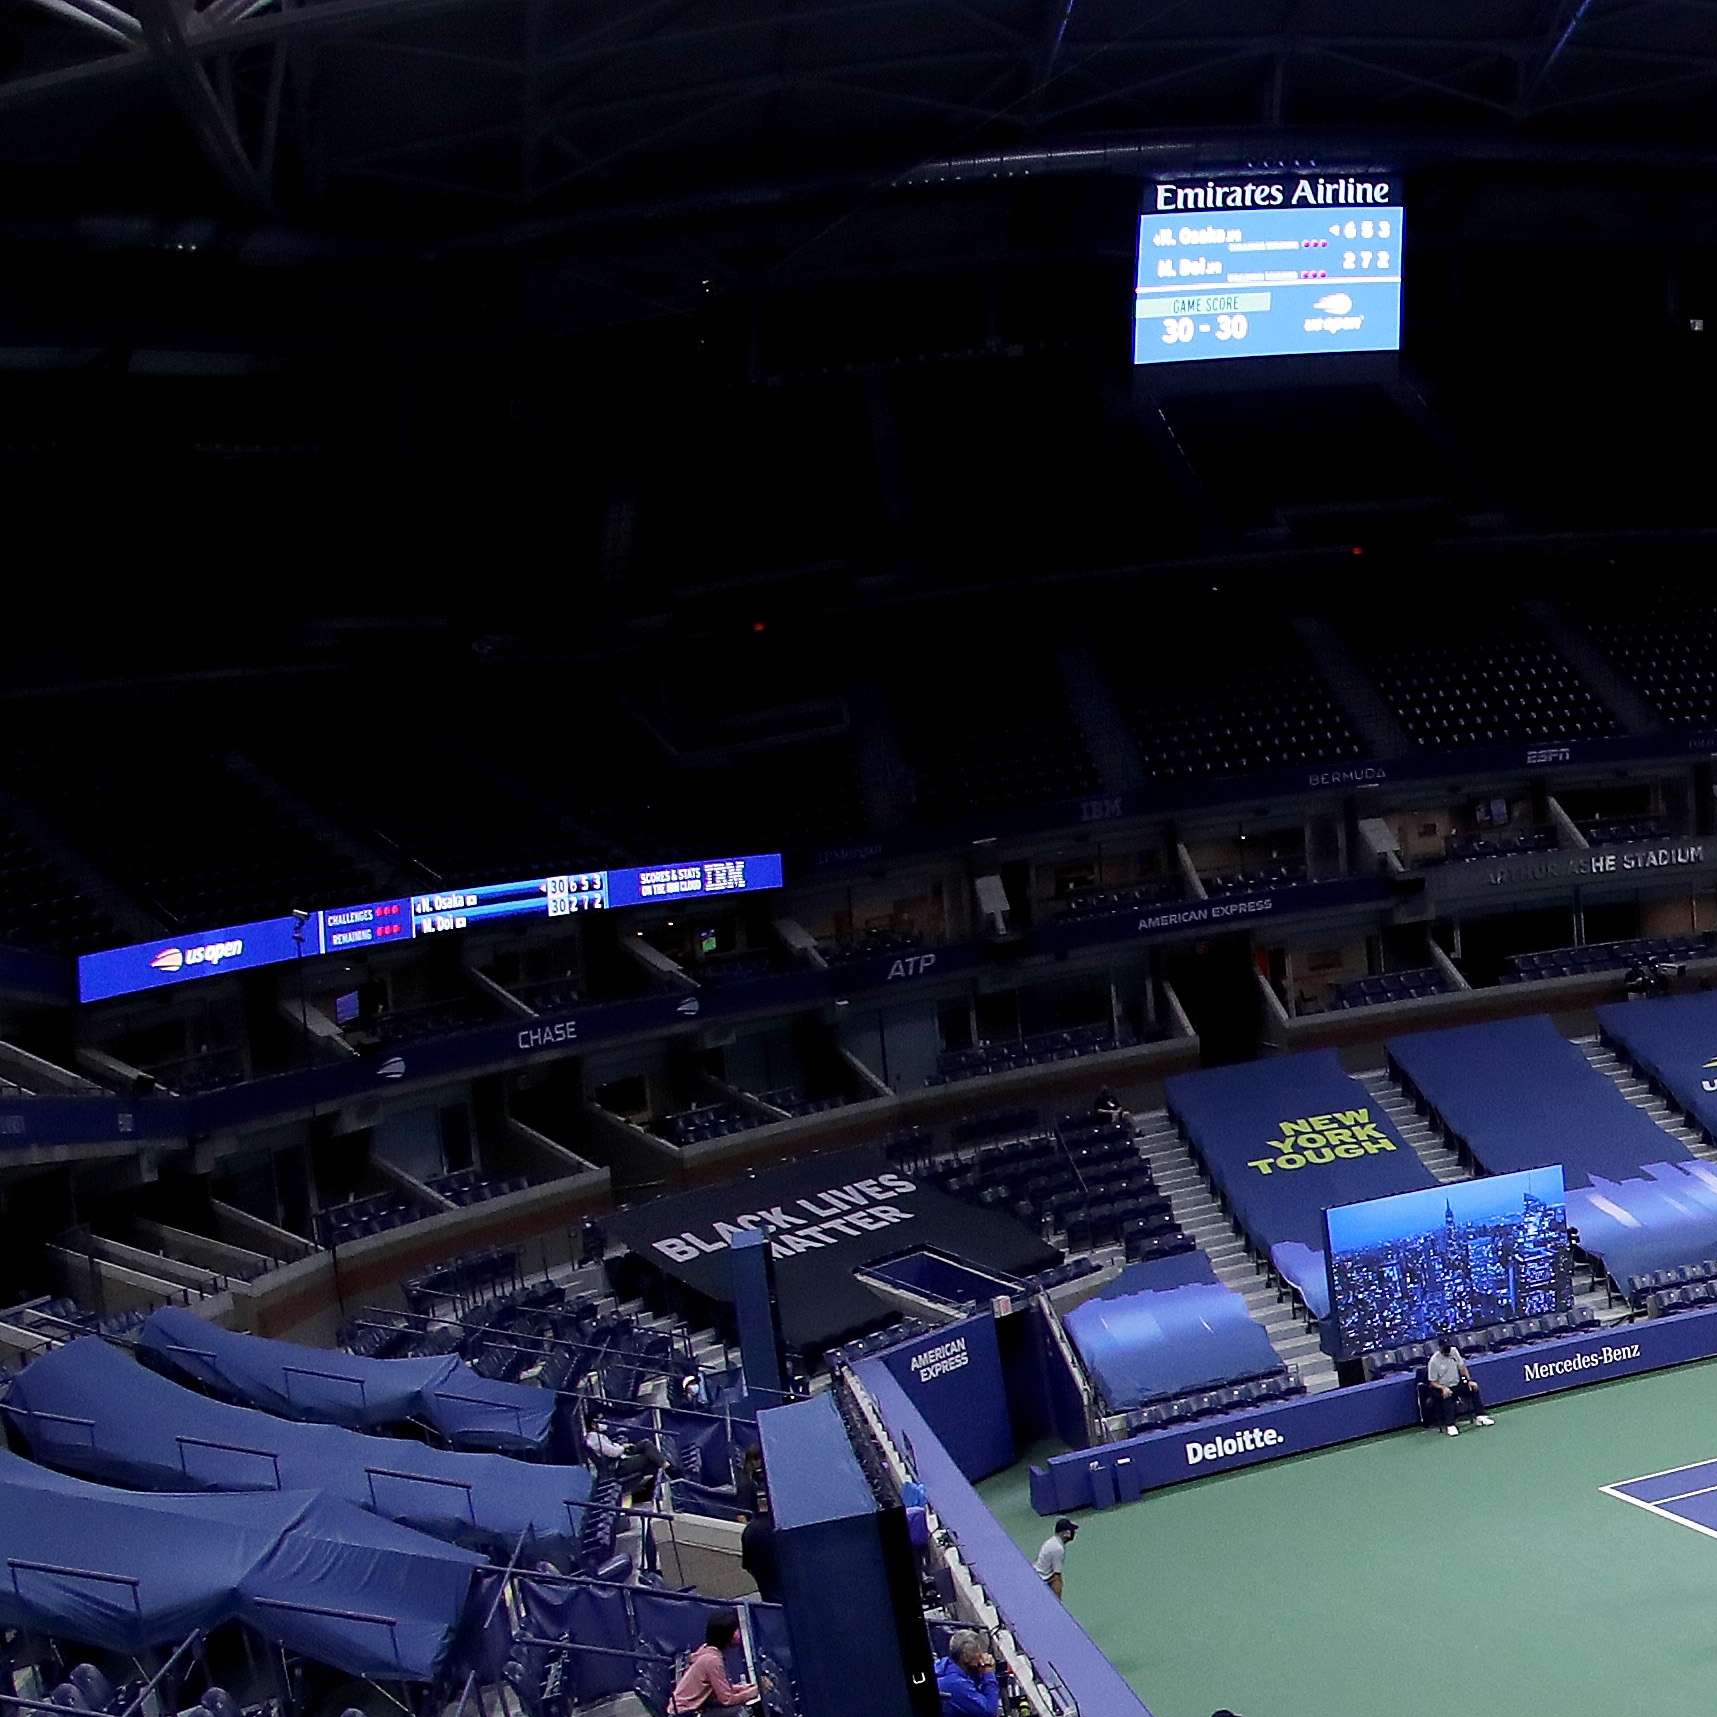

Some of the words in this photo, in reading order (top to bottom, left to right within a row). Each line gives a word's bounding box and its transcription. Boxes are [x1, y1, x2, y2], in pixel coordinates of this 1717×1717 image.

[1156, 181, 1284, 210] Emirates
[1291, 178, 1389, 205] Airline
[1173, 299, 1201, 313] GAME
[1205, 296, 1239, 312] SCORE
[1161, 316, 1194, 344] 30
[1215, 313, 1248, 341] 30
[1526, 748, 1571, 764] ESPN
[1309, 768, 1387, 786] BERMUDA
[1622, 846, 1704, 871] STADIUM
[703, 861, 746, 891] IBM
[434, 894, 465, 911] Osaka
[1137, 909, 1208, 930] AMERICAN
[1211, 899, 1272, 918] EXPRESS
[327, 909, 374, 927] CHALLENGES
[436, 914, 454, 932] Doi
[332, 928, 373, 945] REMAINING
[186, 948, 205, 965] us
[204, 939, 243, 965] open
[887, 953, 936, 980] ATP
[518, 1020, 577, 1049] CHASE
[1279, 1107, 1369, 1136] NEW
[1266, 1122, 1388, 1154] YORK
[1247, 1137, 1398, 1175] TOUGH
[651, 1204, 808, 1263] BLACK
[795, 1173, 917, 1218] LIVES
[769, 1204, 916, 1260] MATTER
[911, 1337, 966, 1371] AMERICAN
[919, 1351, 969, 1382] EXPRESS
[1524, 1344, 1640, 1382] Mercedes-Benz
[1186, 1427, 1284, 1465] Deloitte.
